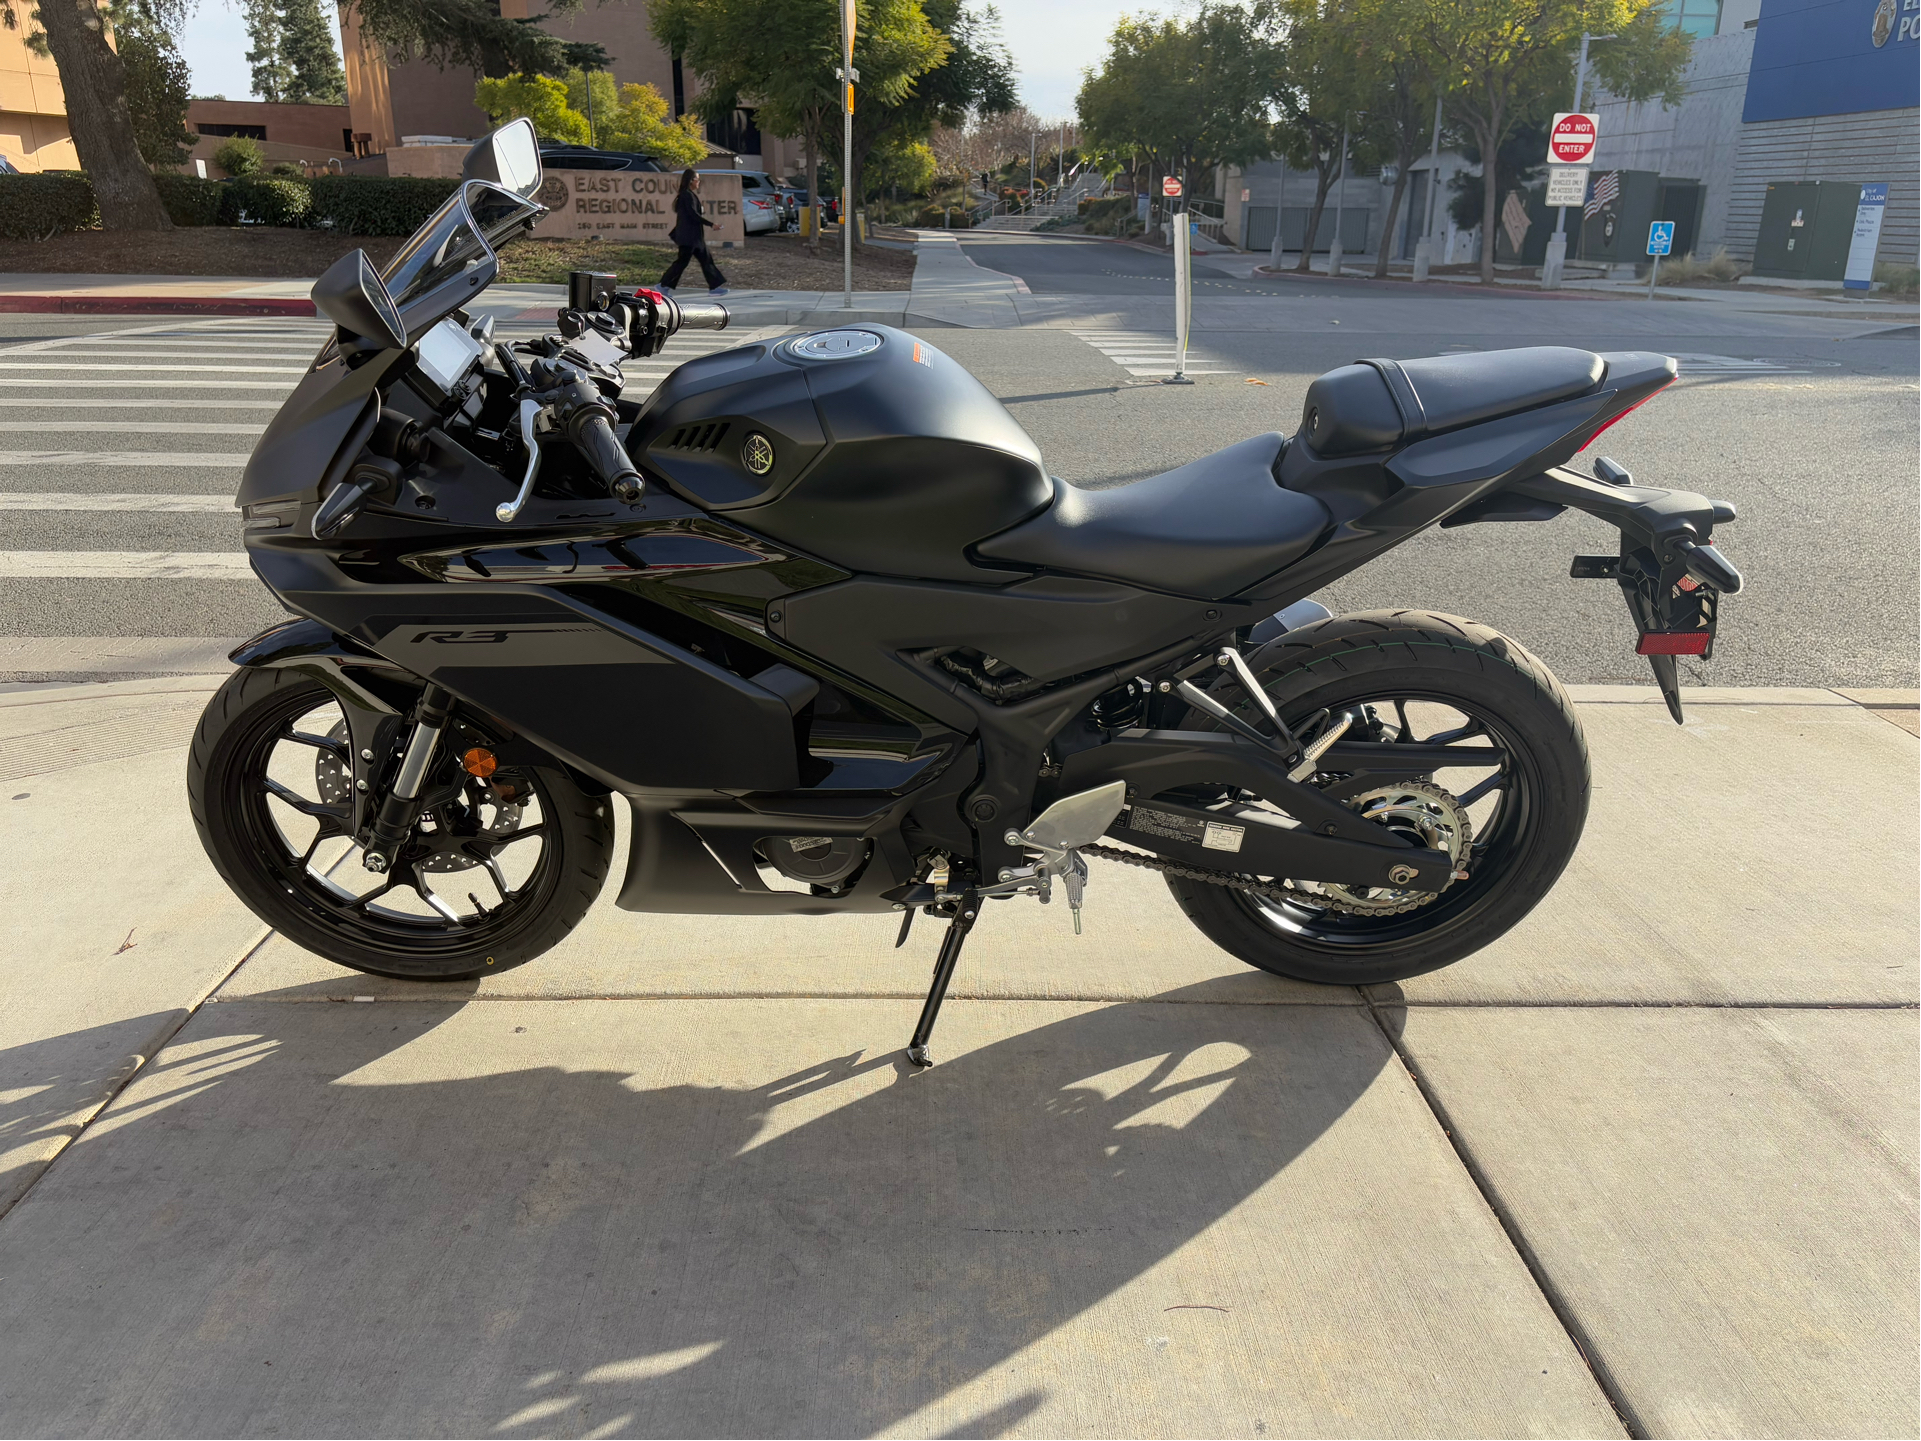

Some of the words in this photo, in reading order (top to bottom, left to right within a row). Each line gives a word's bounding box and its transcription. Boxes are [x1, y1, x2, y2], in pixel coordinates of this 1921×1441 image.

[1559, 123, 1571, 132] DO
[1575, 124, 1591, 132] NOT
[1559, 145, 1585, 153] ENTER
[574, 176, 622, 193] EAST
[575, 198, 666, 214] REGIONAL
[596, 222, 616, 230] EAST
[620, 222, 638, 230] MAIN
[642, 222, 669, 230] STREET
[410, 630, 509, 644] R3
